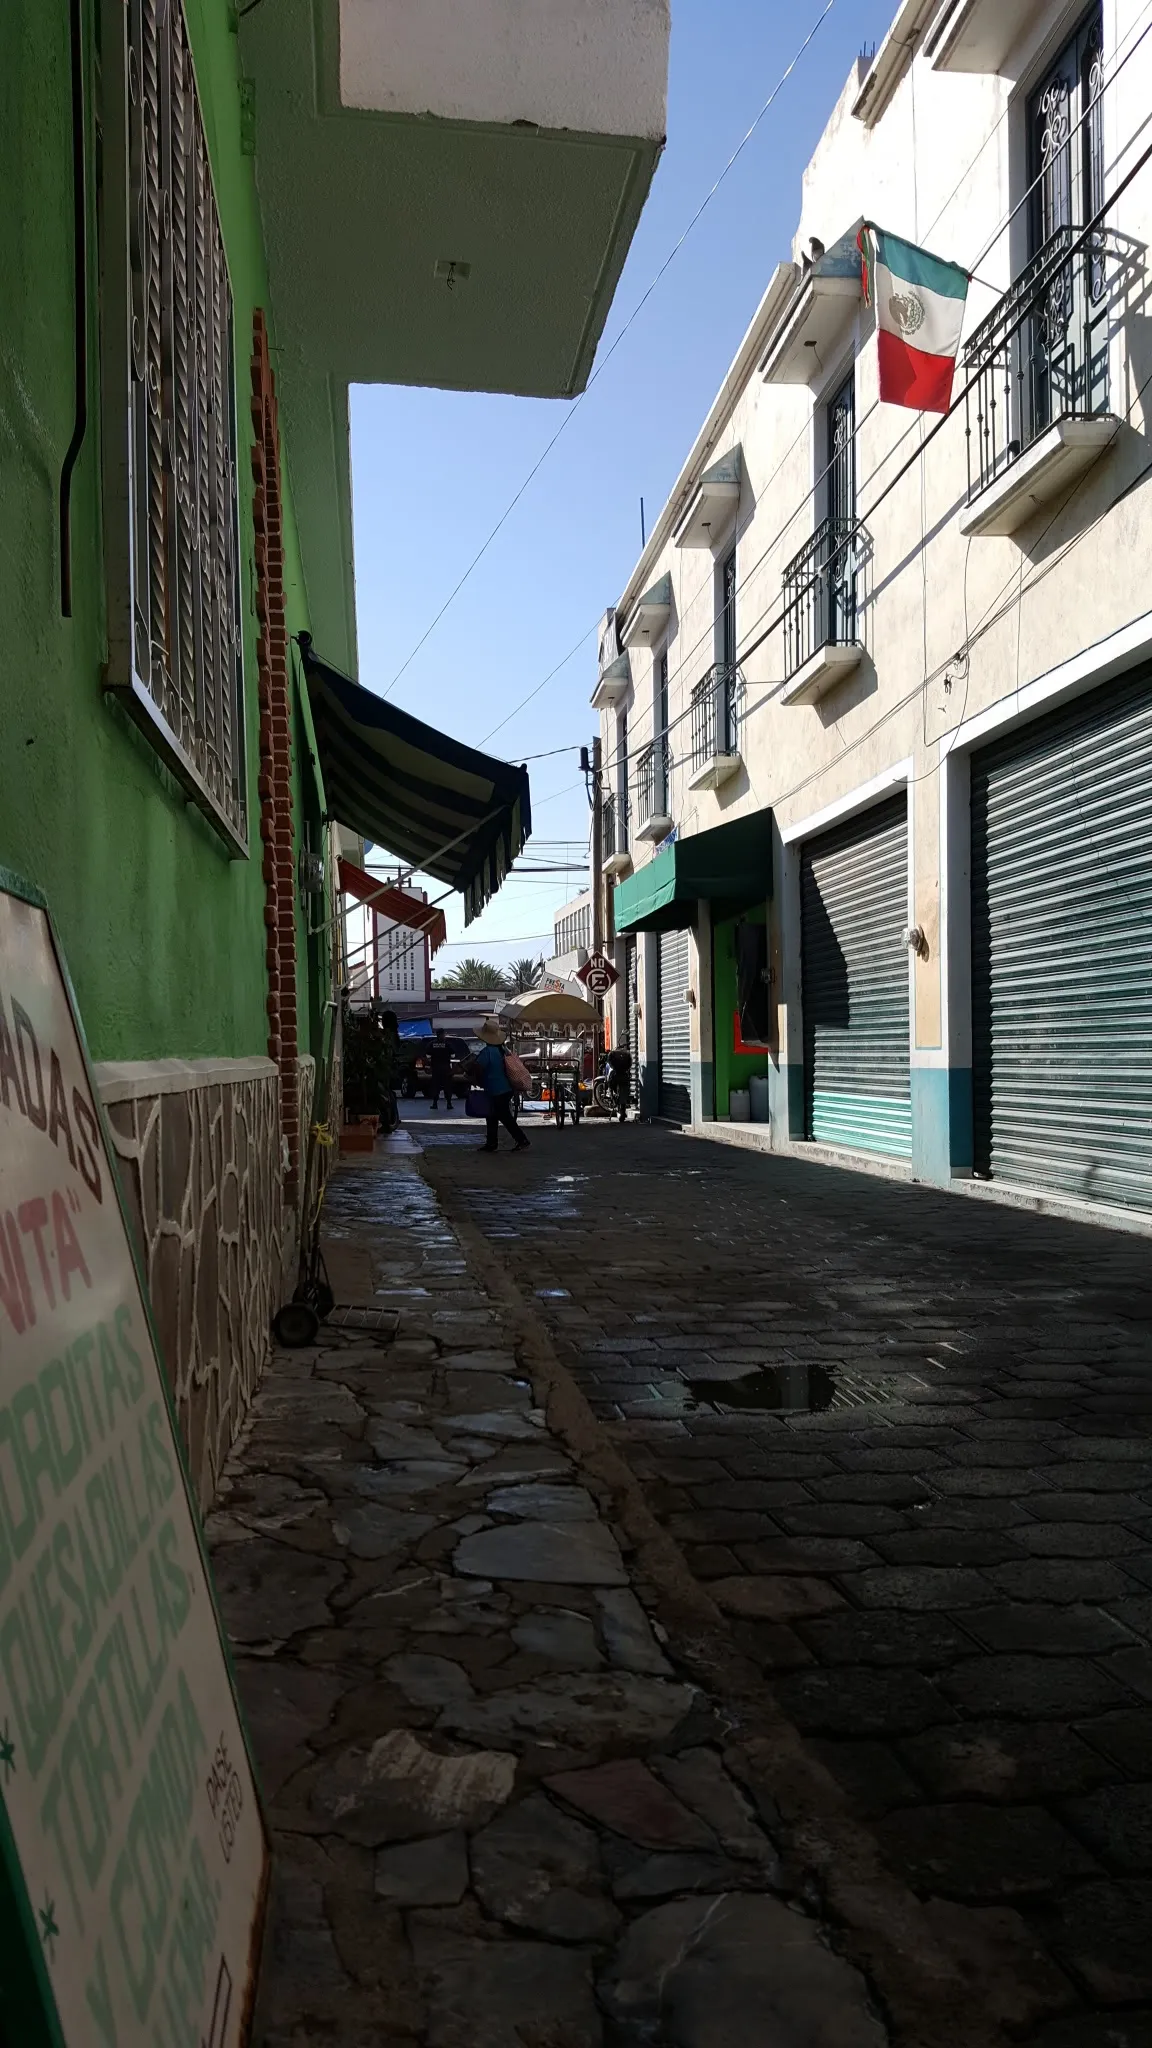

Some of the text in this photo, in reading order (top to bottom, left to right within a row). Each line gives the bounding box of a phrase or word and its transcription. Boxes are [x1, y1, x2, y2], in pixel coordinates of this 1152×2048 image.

[590, 958, 604, 968] NO
[1, 1399, 175, 1780] QUESADILLAS
[41, 1517, 190, 1938] TORTILLAS
[206, 1730, 231, 1820] PASE
[218, 1771, 242, 1864] USTED
[110, 1668, 208, 2024] COMIDA
